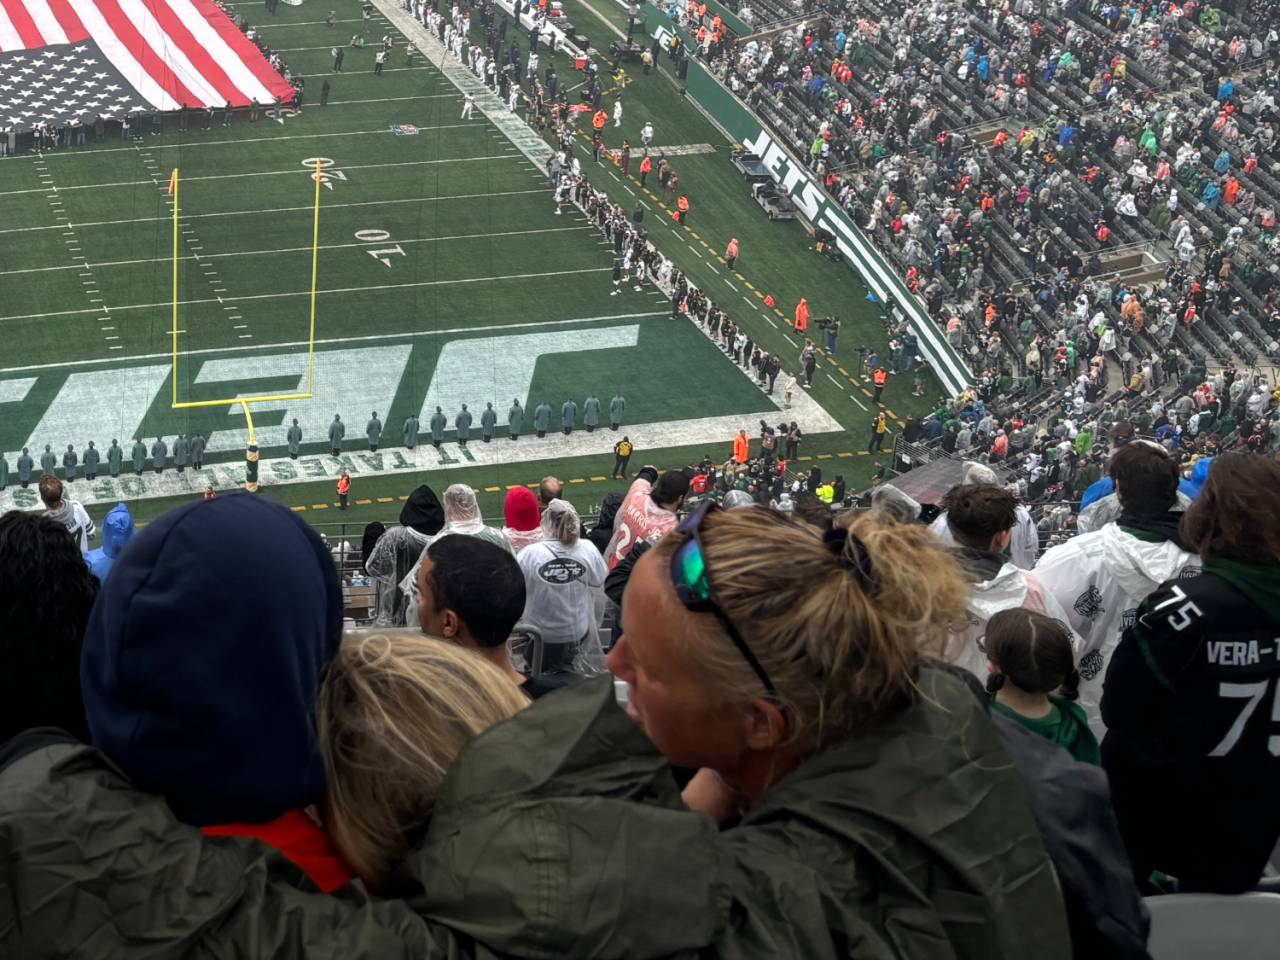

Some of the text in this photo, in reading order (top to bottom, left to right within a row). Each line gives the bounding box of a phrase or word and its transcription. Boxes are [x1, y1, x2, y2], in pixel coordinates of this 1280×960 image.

[301, 156, 348, 182] 20
[743, 129, 827, 222] JETS
[354, 228, 407, 259] 10
[271, 449, 418, 481] TAKES
[436, 444, 477, 465] IT
[94, 476, 148, 499] OF
[1154, 584, 1204, 632] 75
